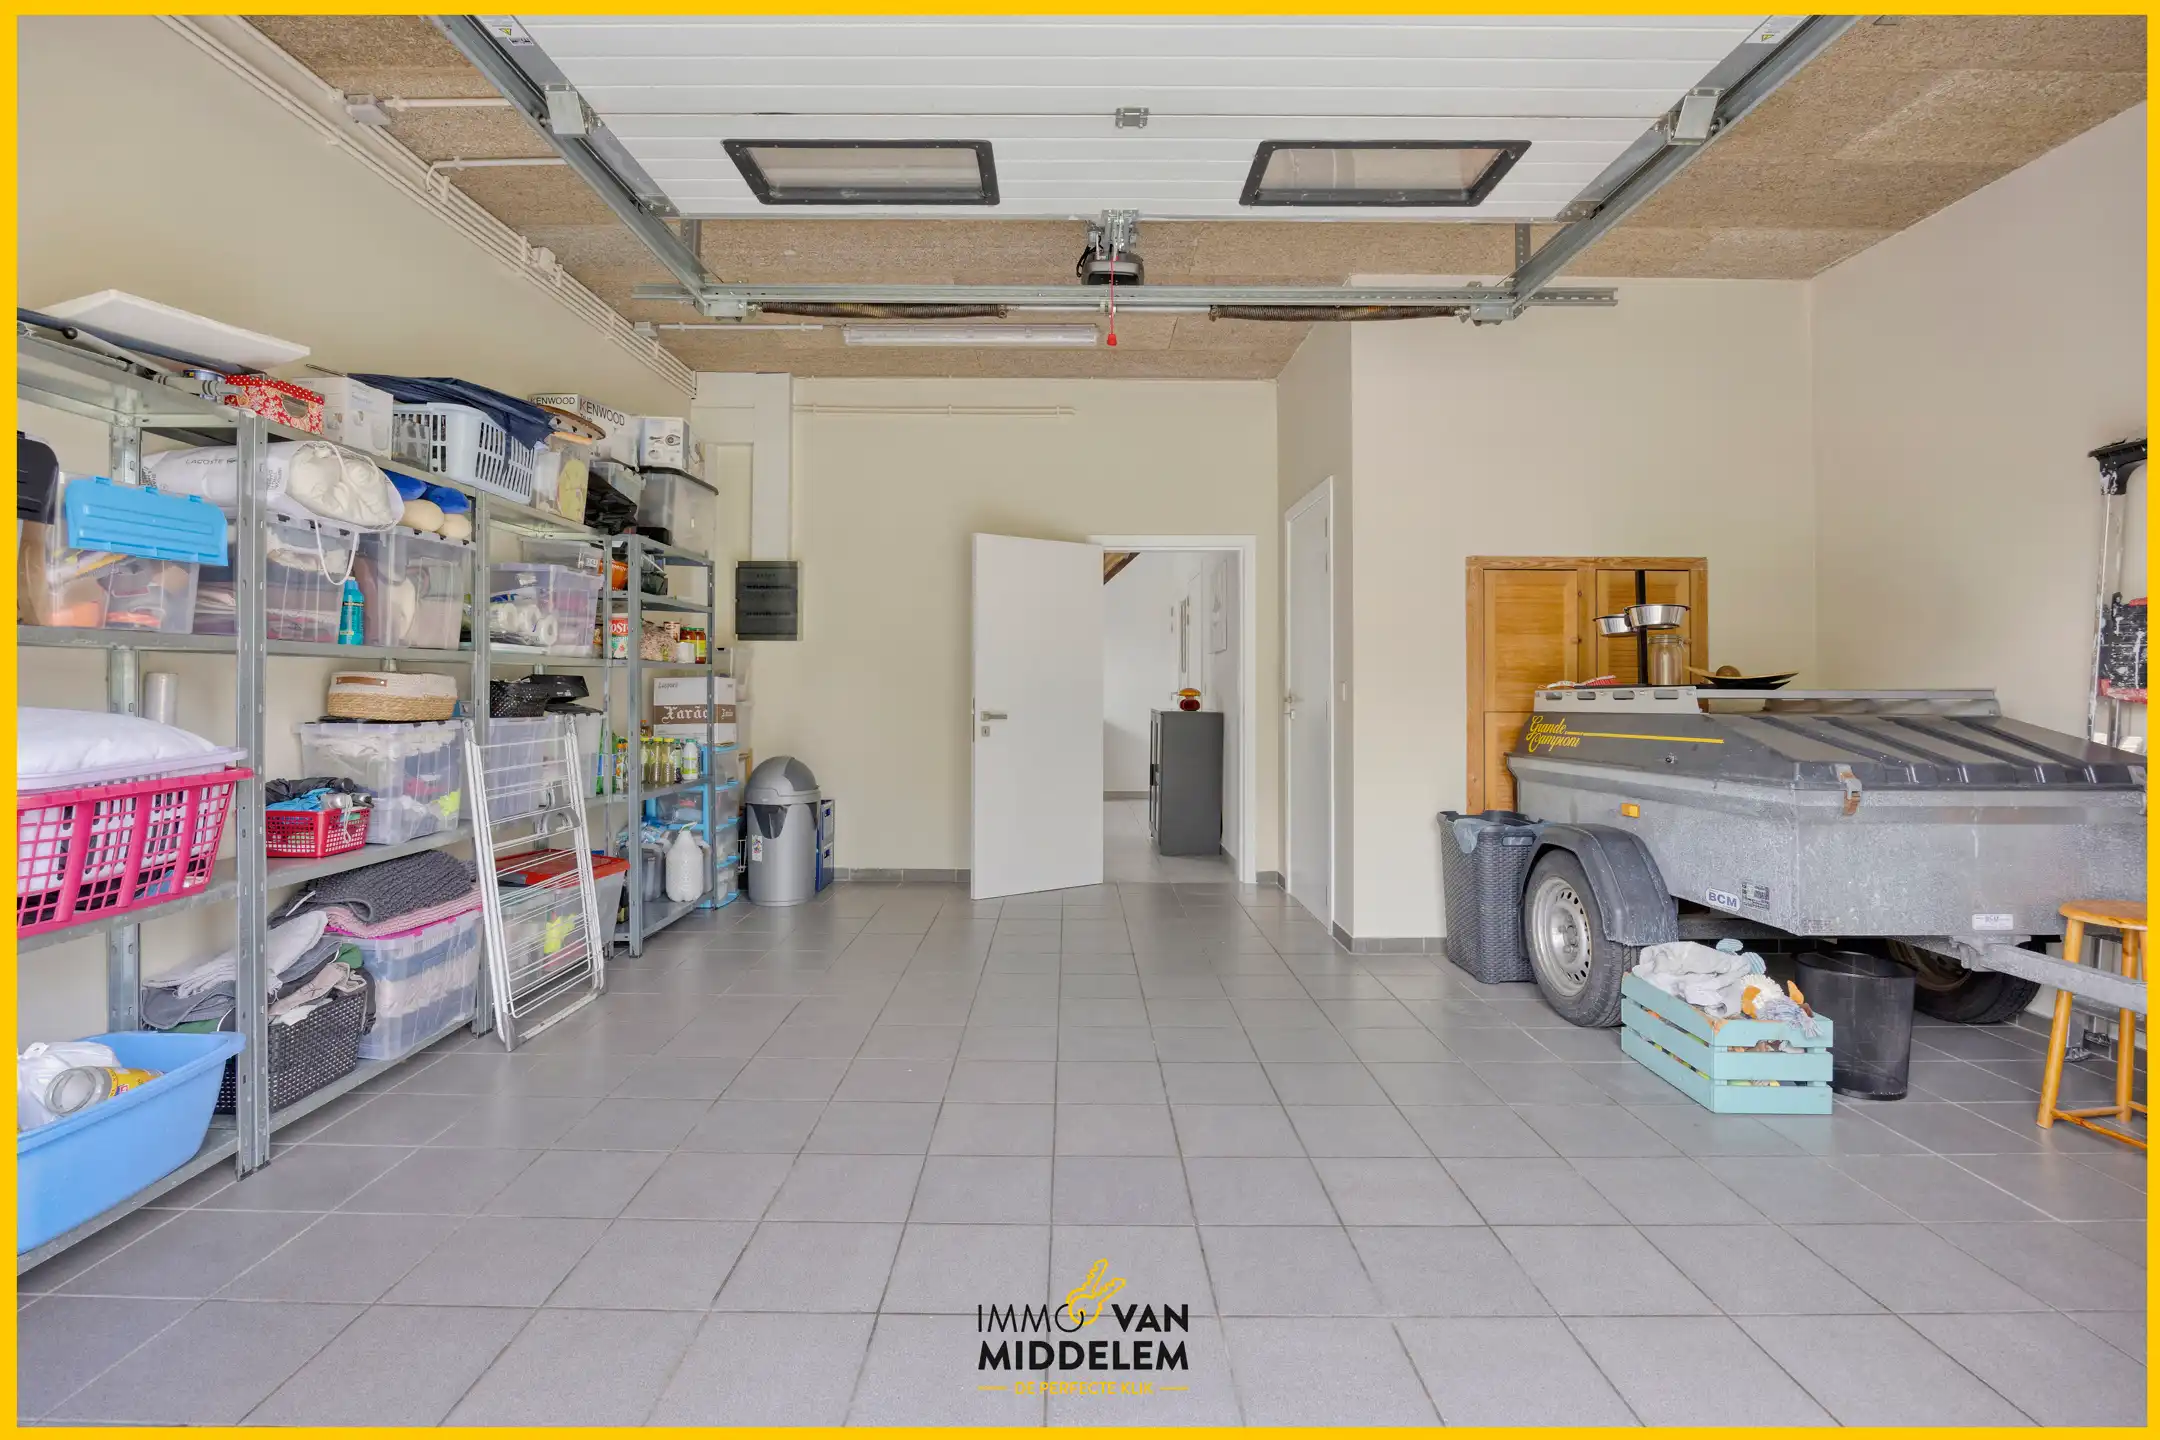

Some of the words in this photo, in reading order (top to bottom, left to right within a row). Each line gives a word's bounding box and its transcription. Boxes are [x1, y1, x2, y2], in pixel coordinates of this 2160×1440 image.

[531, 397, 576, 405] KENWOOD
[580, 398, 625, 426] KENWOOD
[1526, 716, 1567, 741] Grande
[1529, 733, 1580, 752] Campioni
[1708, 891, 1738, 908] BCM
